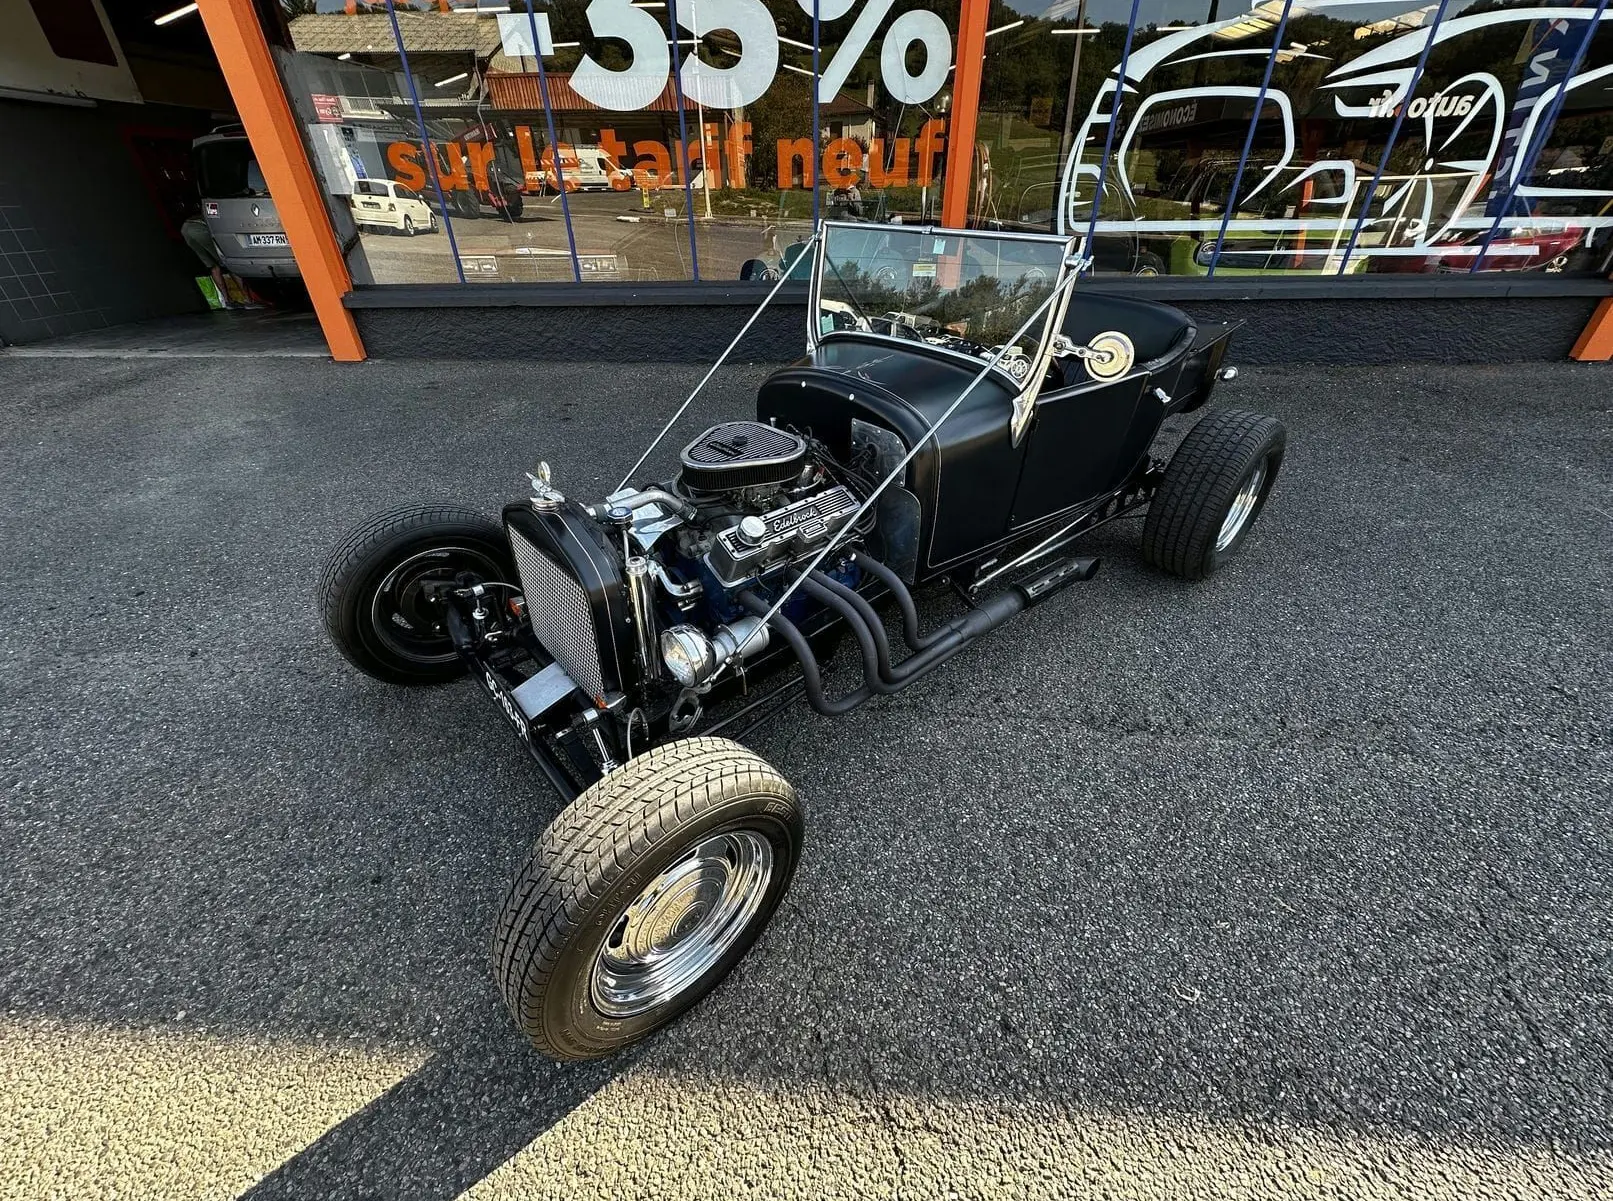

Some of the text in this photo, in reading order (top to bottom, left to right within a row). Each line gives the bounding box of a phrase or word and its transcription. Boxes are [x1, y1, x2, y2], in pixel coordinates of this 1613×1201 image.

[387, 118, 946, 192] sur le tarif neuf
[773, 507, 818, 532] Edelbrock
